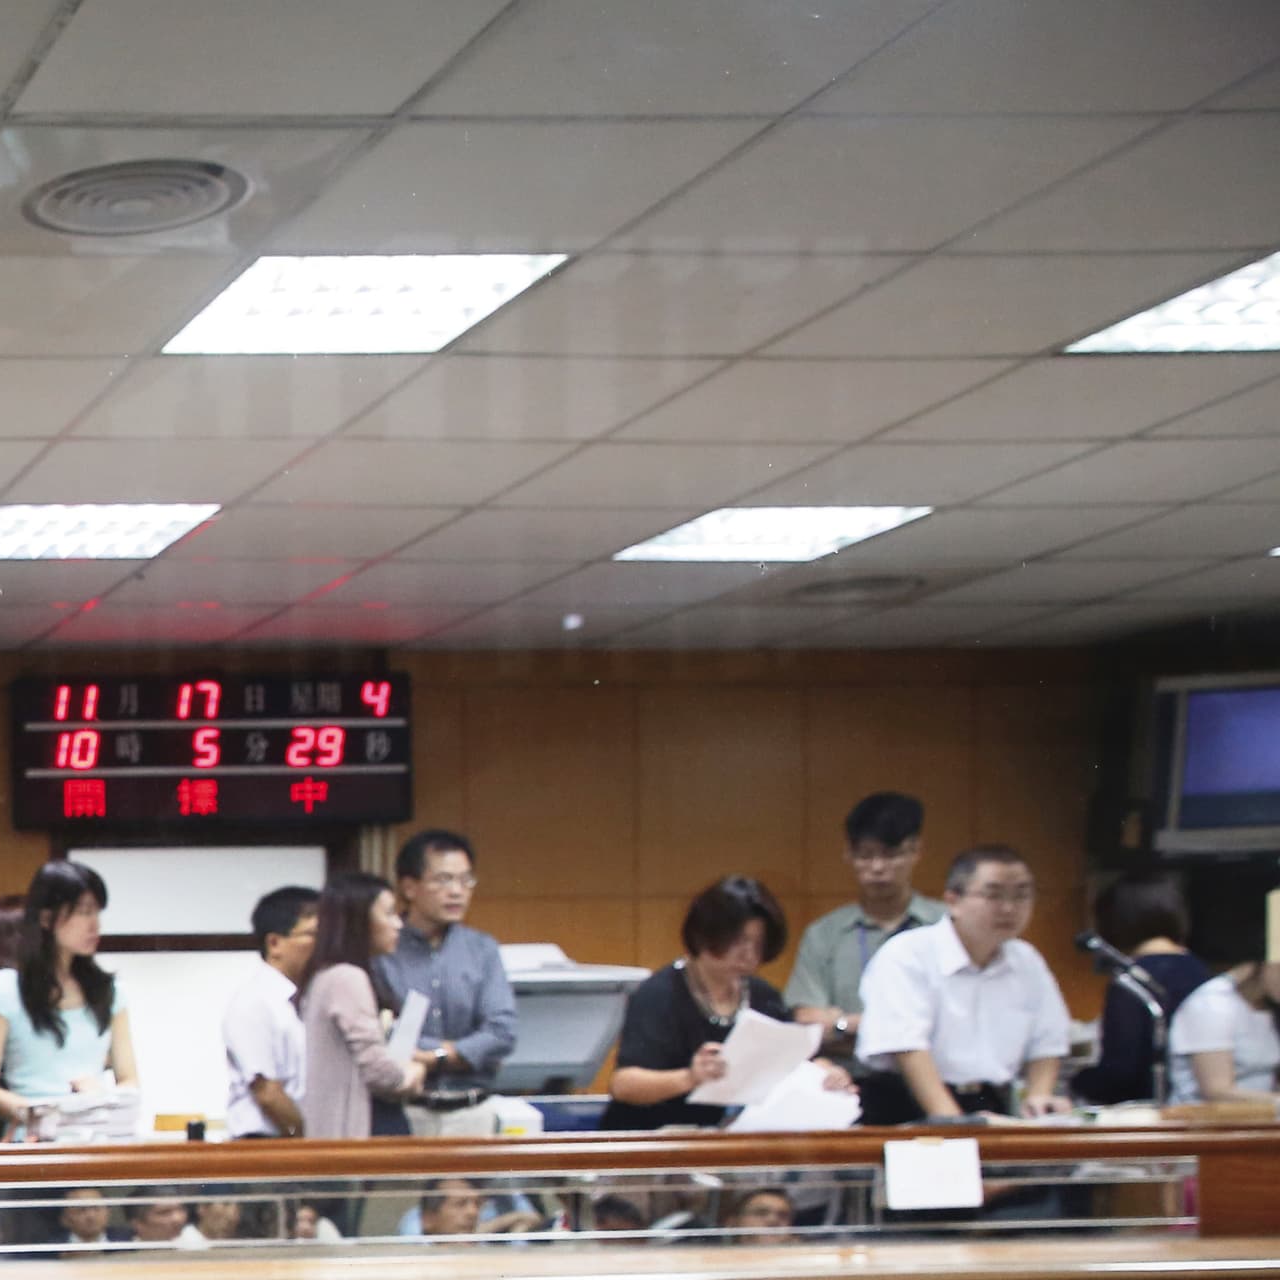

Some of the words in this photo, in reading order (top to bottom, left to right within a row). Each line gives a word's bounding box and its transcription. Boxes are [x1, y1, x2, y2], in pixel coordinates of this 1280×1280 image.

[55, 684, 99, 721] 11
[176, 680, 221, 721] 17
[360, 680, 391, 718] 4
[56, 727, 100, 770] 10
[192, 725, 221, 769] 5
[285, 724, 346, 767] 29
